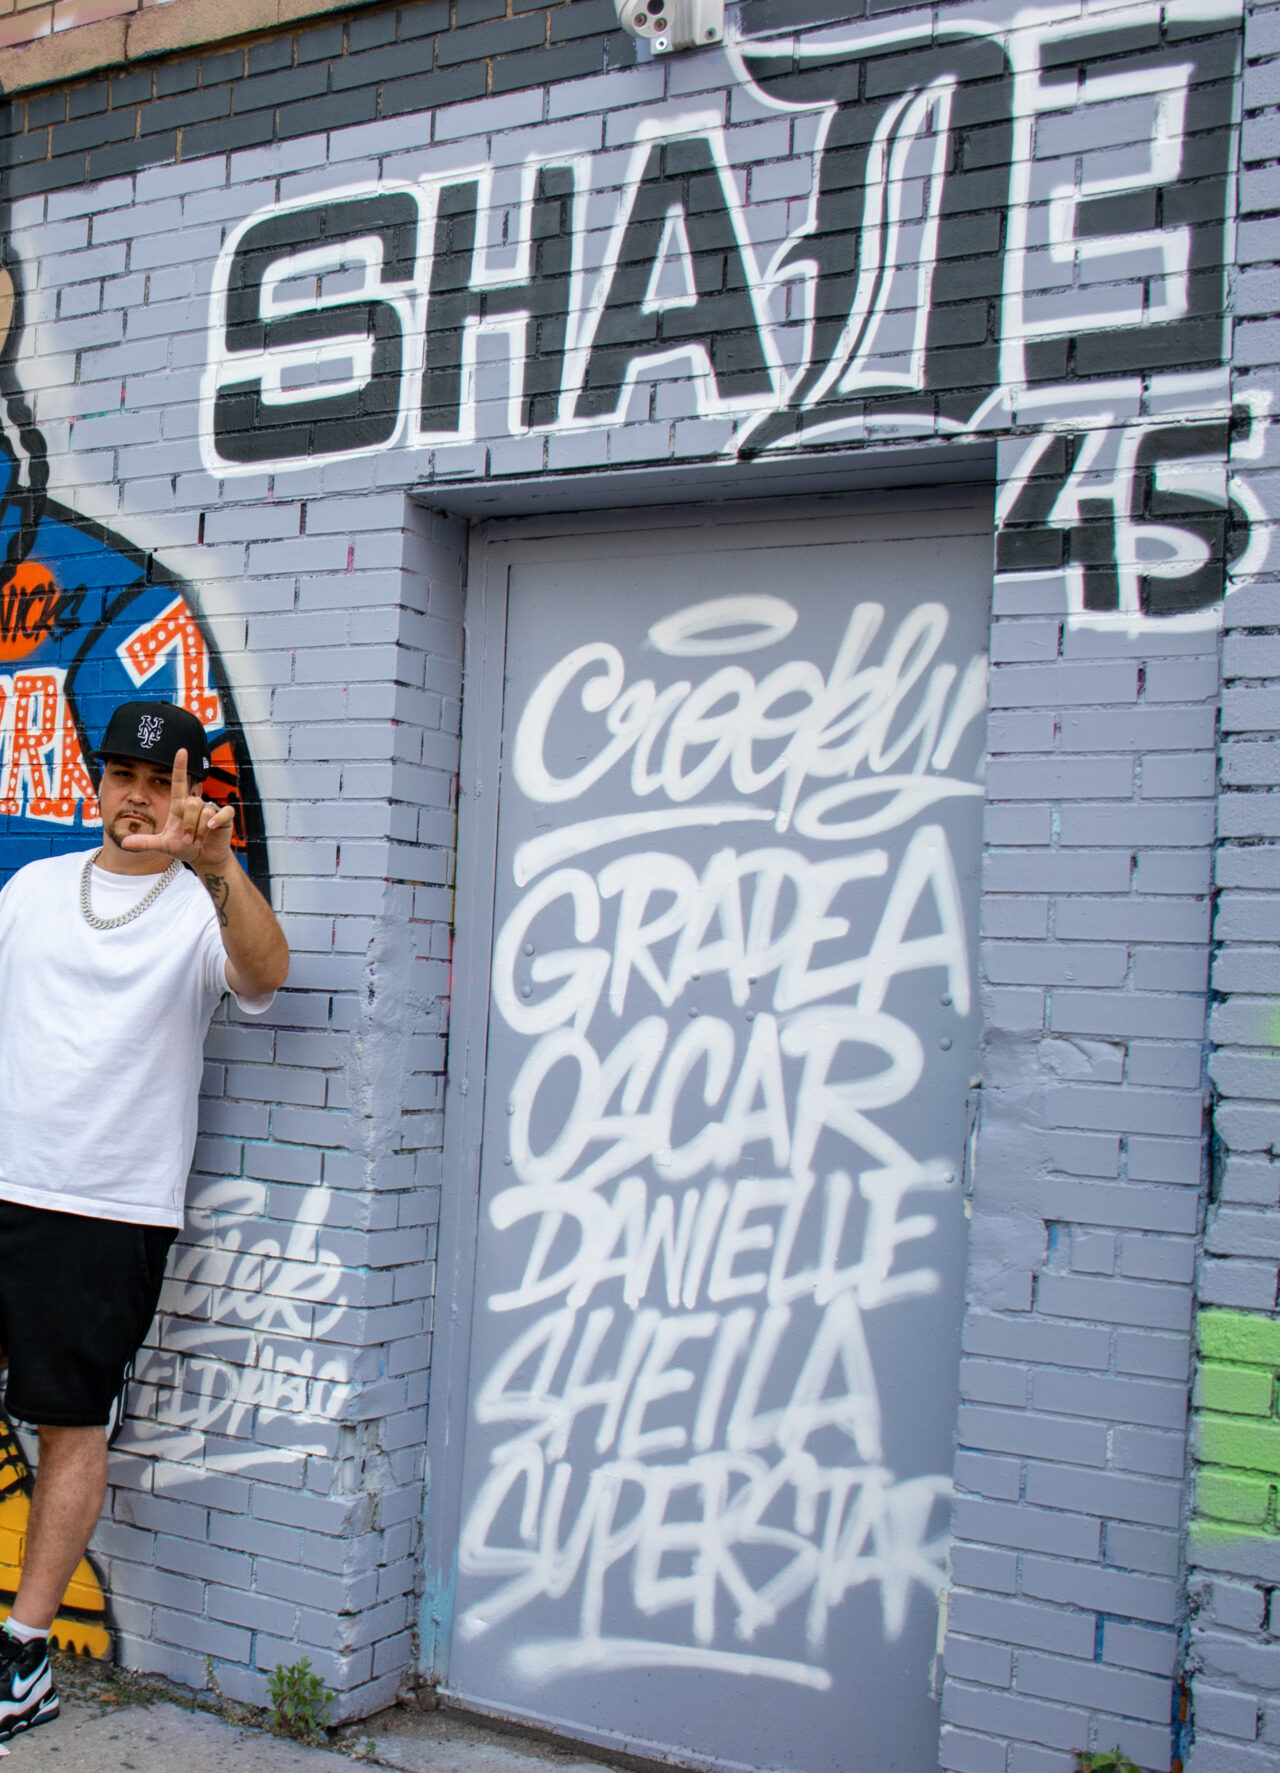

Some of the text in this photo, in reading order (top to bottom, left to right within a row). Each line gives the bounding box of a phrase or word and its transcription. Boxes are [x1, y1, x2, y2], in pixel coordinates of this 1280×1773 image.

[508, 1005, 926, 1192] OSCAR
[488, 1158, 956, 1312] DANIELLE
[474, 1294, 884, 1465] SHEILA
[457, 1443, 955, 1650] SUPERSTAR
